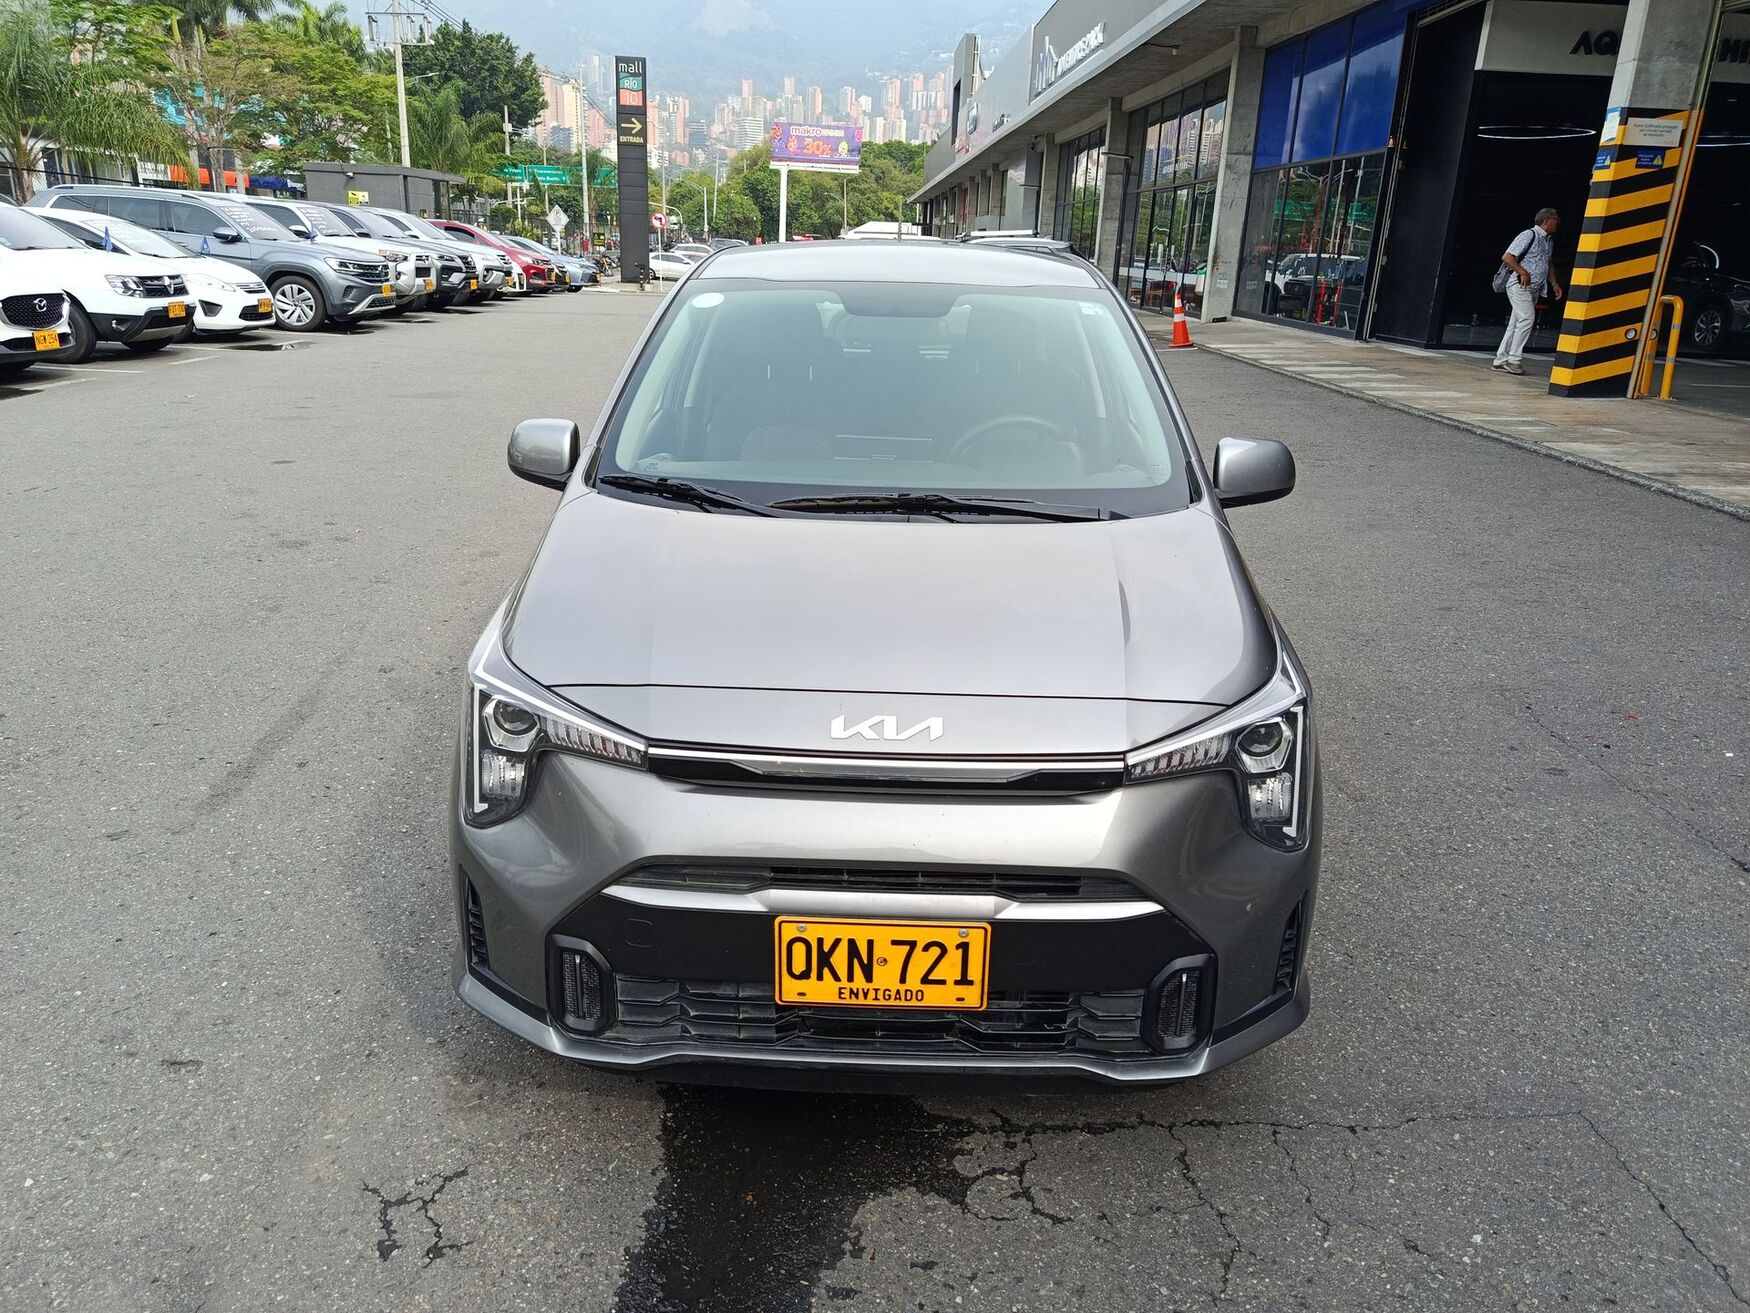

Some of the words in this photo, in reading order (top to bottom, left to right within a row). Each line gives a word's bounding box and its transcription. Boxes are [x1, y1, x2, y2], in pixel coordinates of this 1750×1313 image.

[618, 61, 643, 73] mall
[624, 93, 638, 105] 10
[619, 135, 644, 144] ENTRADA
[830, 714, 944, 742] KIA
[786, 936, 875, 984] QKN
[890, 939, 975, 987] 721
[838, 986, 925, 1002] ENVIGADO
